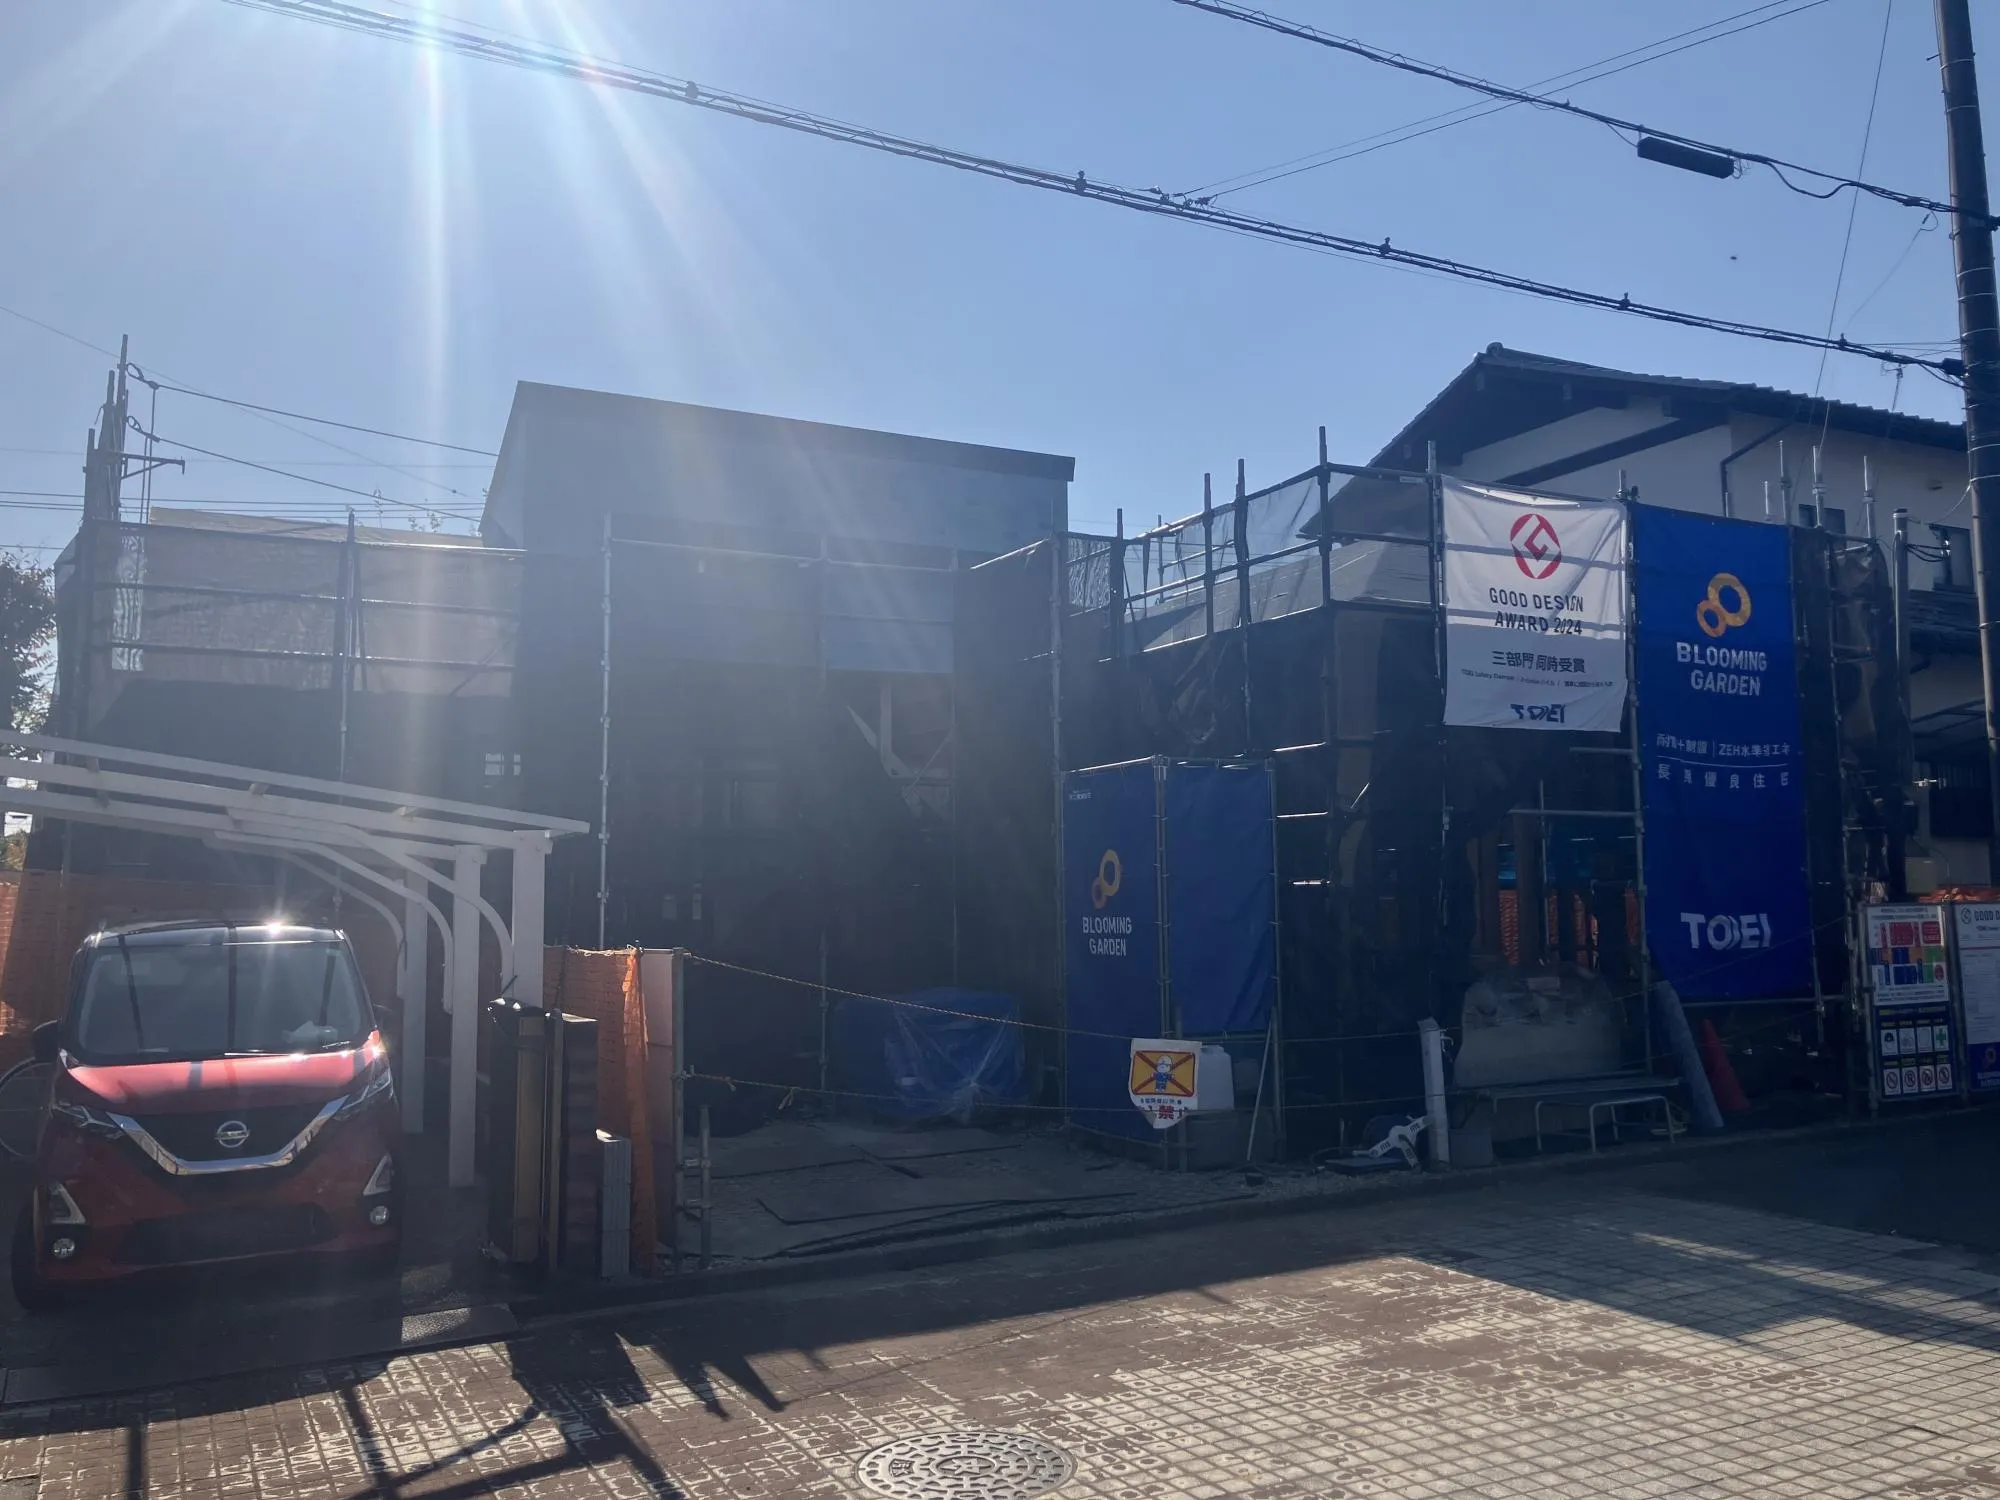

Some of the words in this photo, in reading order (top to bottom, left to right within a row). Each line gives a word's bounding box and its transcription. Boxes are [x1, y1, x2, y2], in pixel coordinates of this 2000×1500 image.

[1489, 588, 1528, 608] GOOD
[1533, 595, 1583, 612] DESIGN
[1495, 611, 1549, 632] AWARD
[1553, 618, 1582, 635] 2024
[1492, 650, 1585, 673] 三部門同時受賞
[1676, 642, 1767, 672] BLOOMING
[1691, 669, 1761, 697] GARDEN
[1510, 703, 1566, 723] TOEI
[1082, 916, 1132, 935] BLOOMING
[1680, 912, 1772, 950] TOEI
[1089, 938, 1127, 957] GARDEN
